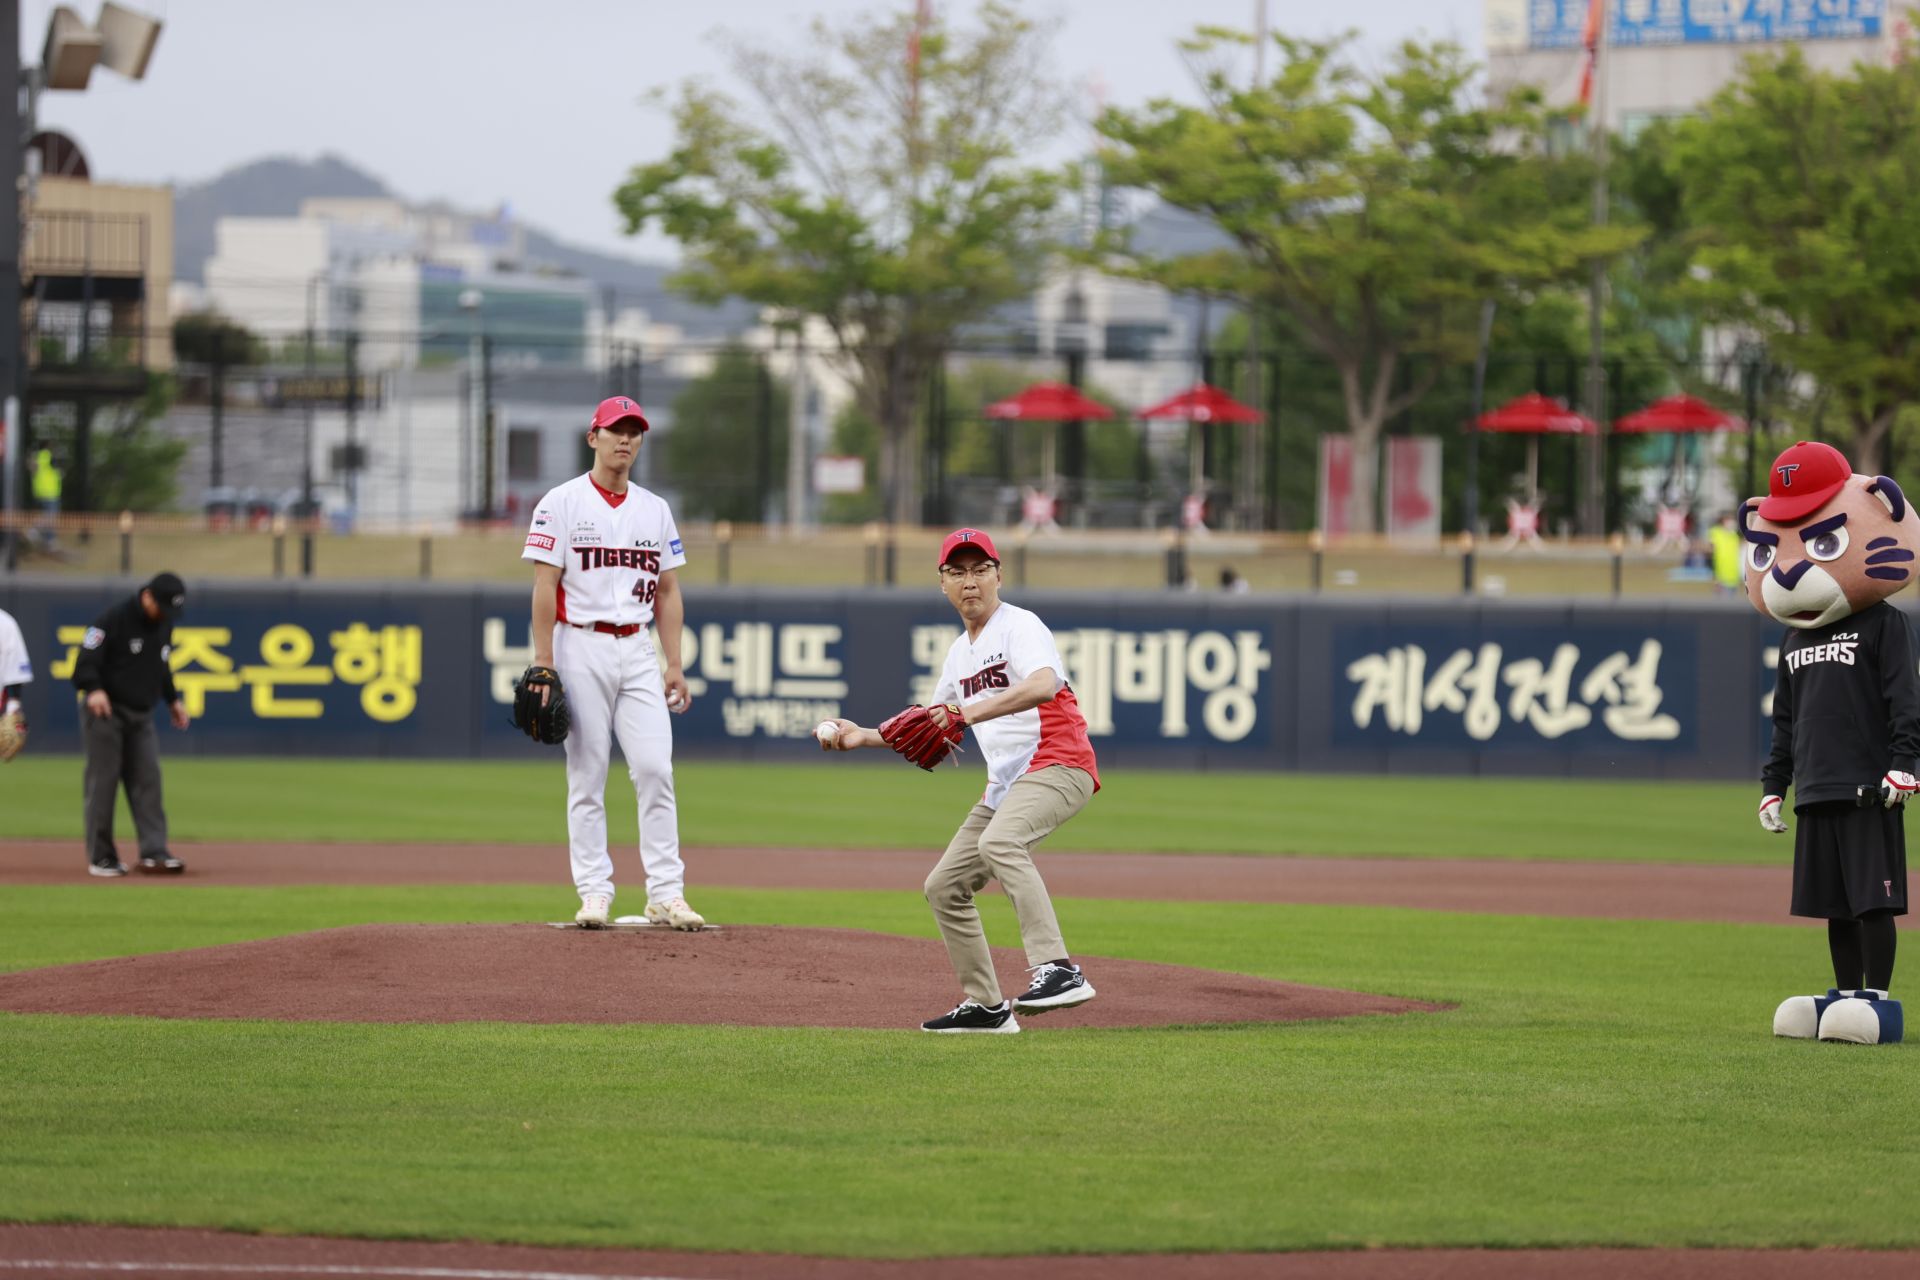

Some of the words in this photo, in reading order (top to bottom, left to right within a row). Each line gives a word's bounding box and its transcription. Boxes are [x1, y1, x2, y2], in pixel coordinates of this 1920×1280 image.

[616, 399, 631, 411] T
[1777, 464, 1800, 488] T
[955, 531, 976, 543] T
[572, 547, 662, 576] TIGERS
[632, 578, 657, 604] 48
[1785, 642, 1860, 675] TIGERS
[959, 661, 1011, 700] TGERS
[1346, 637, 1681, 740] 계성건설
